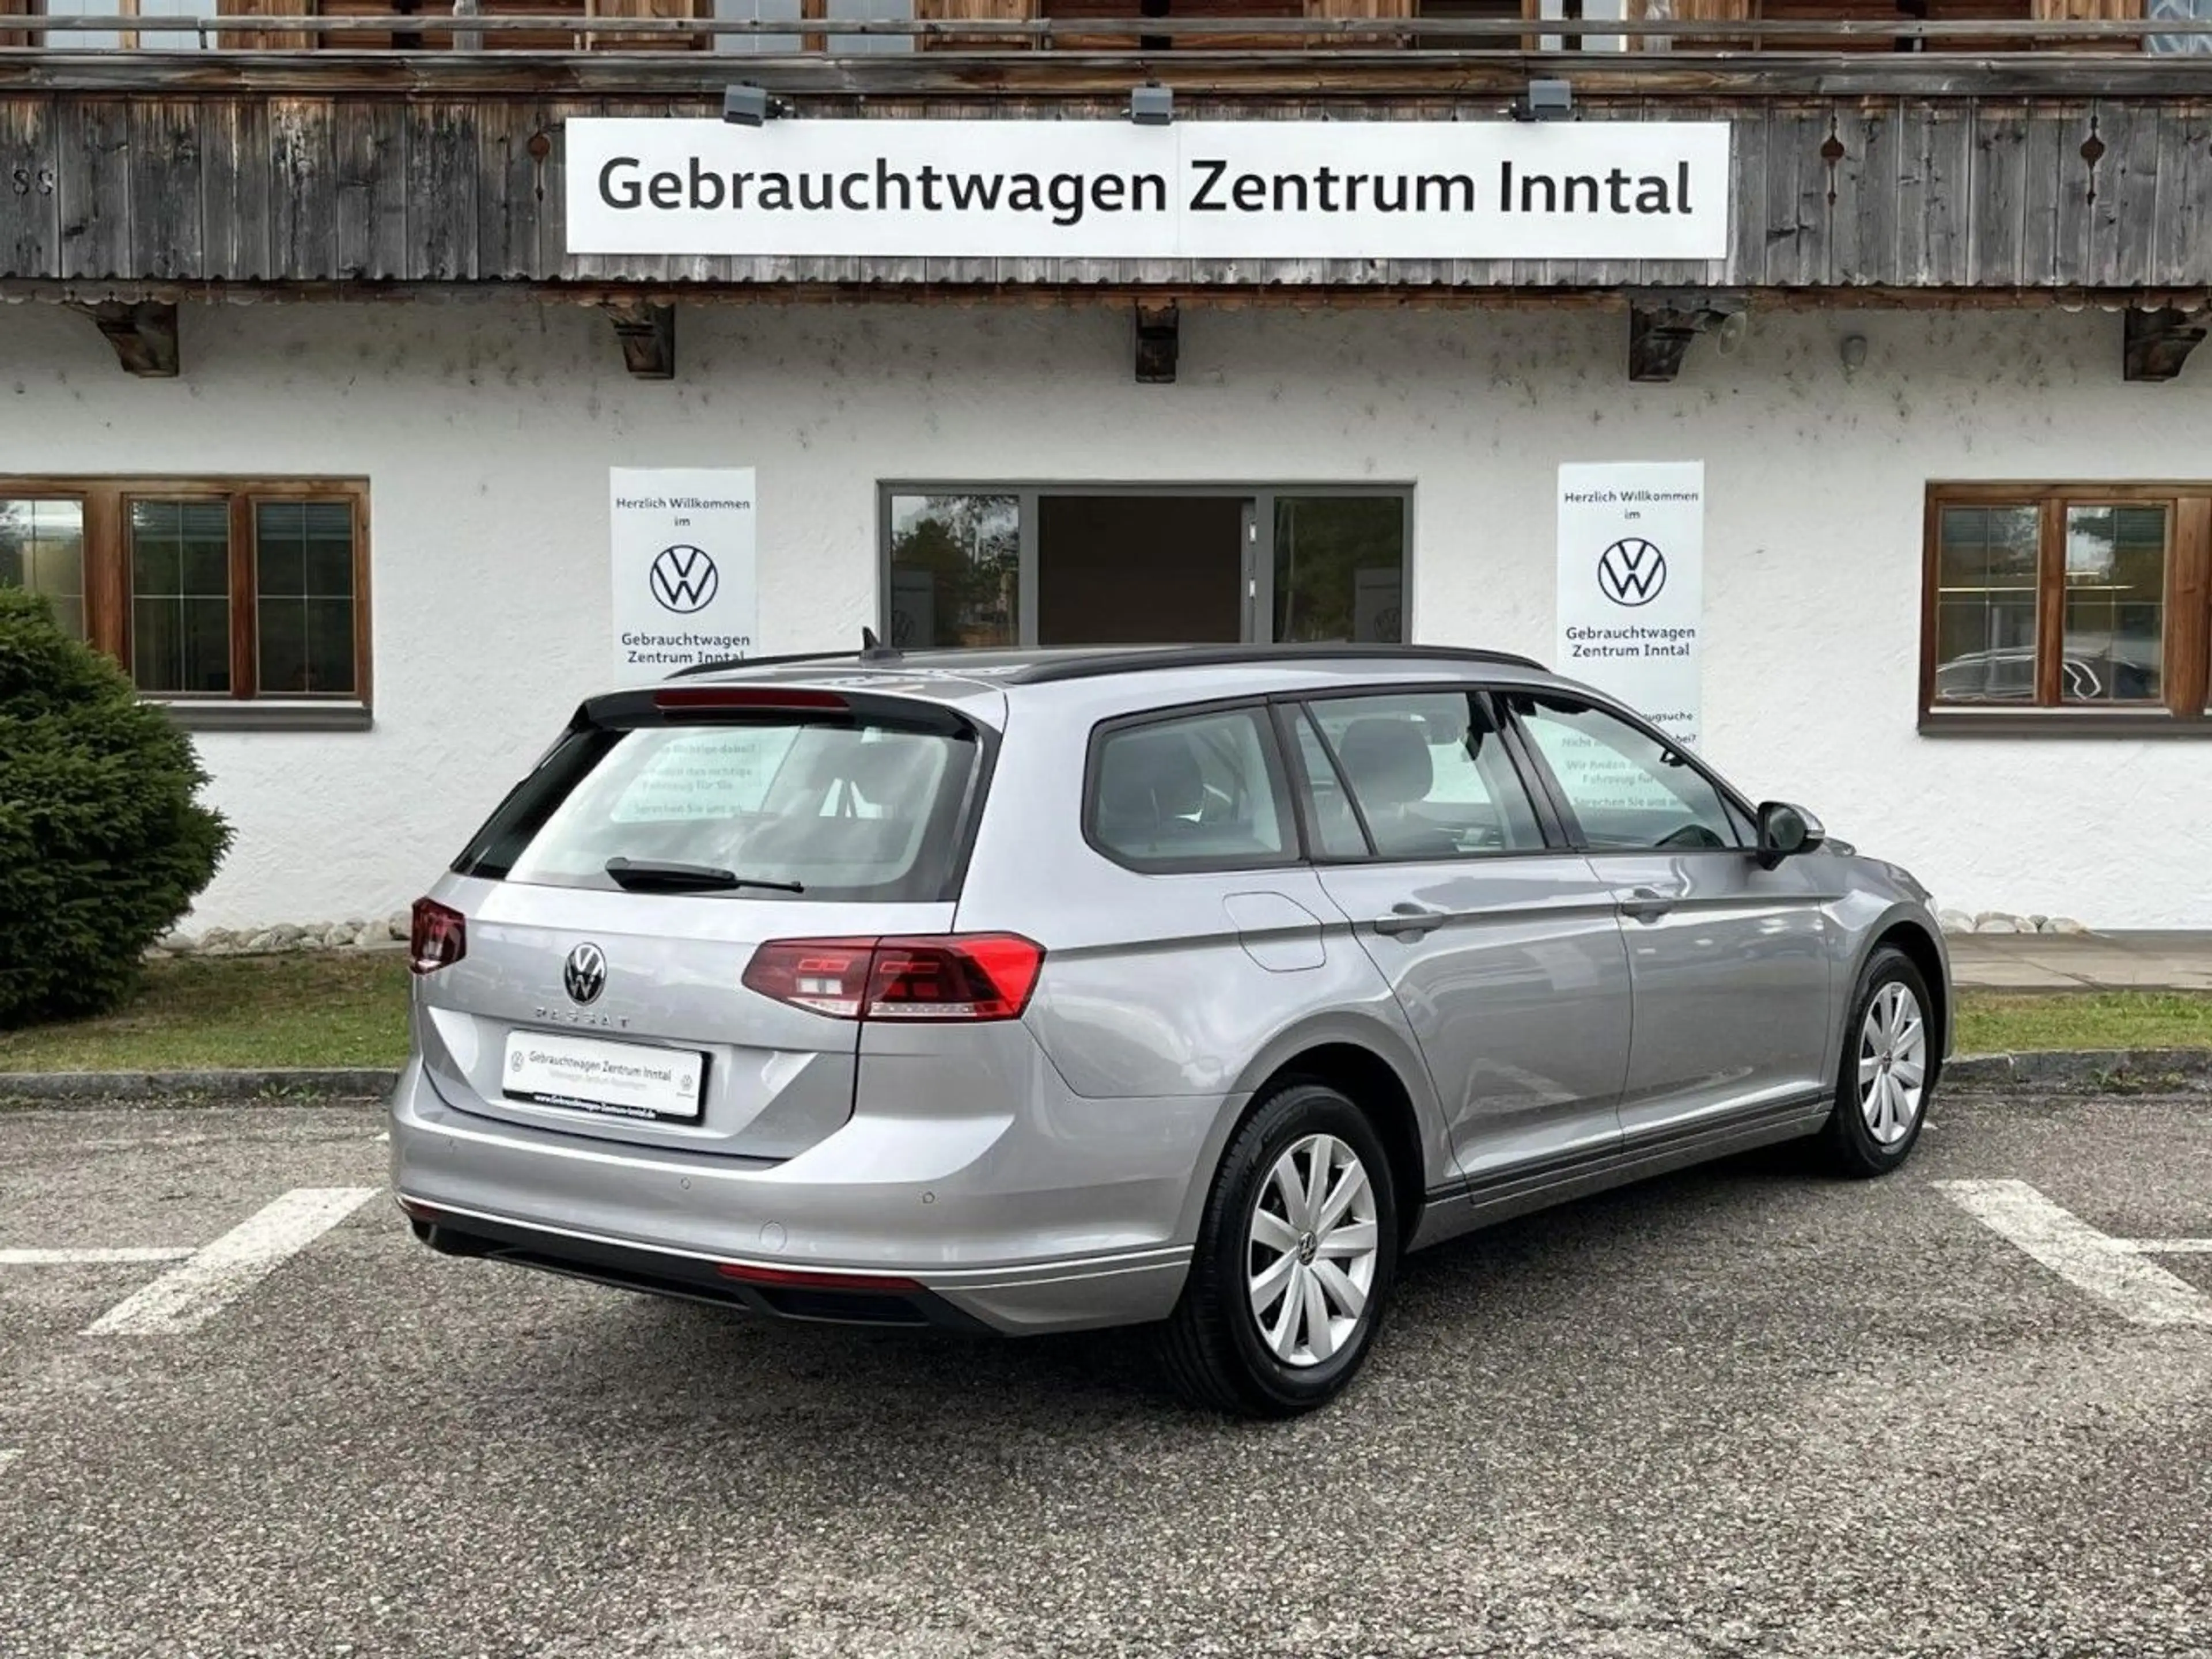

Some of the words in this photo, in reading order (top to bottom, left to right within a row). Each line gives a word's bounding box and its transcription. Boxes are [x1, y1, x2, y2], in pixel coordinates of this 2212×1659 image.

[599, 157, 1165, 226] Gebrauchtwagen
[1190, 160, 1474, 213] Zentrum
[1501, 160, 1692, 214] Inntal
[616, 497, 666, 509] Herzlich
[669, 497, 751, 509] Willkommen
[1565, 491, 1617, 503] Herzlich
[1620, 490, 1698, 503] Willkommen
[1624, 509, 1641, 520] im
[674, 517, 691, 527] im
[622, 632, 751, 649] Gebrauchtwagen
[1566, 626, 1696, 641] Gebrauchtwagen
[628, 650, 692, 663] Zentrum
[698, 650, 744, 663] Inntal
[1573, 645, 1639, 658] Zentrum
[1645, 643, 1690, 657] Inntal
[603, 1060, 641, 1077] Zentrum
